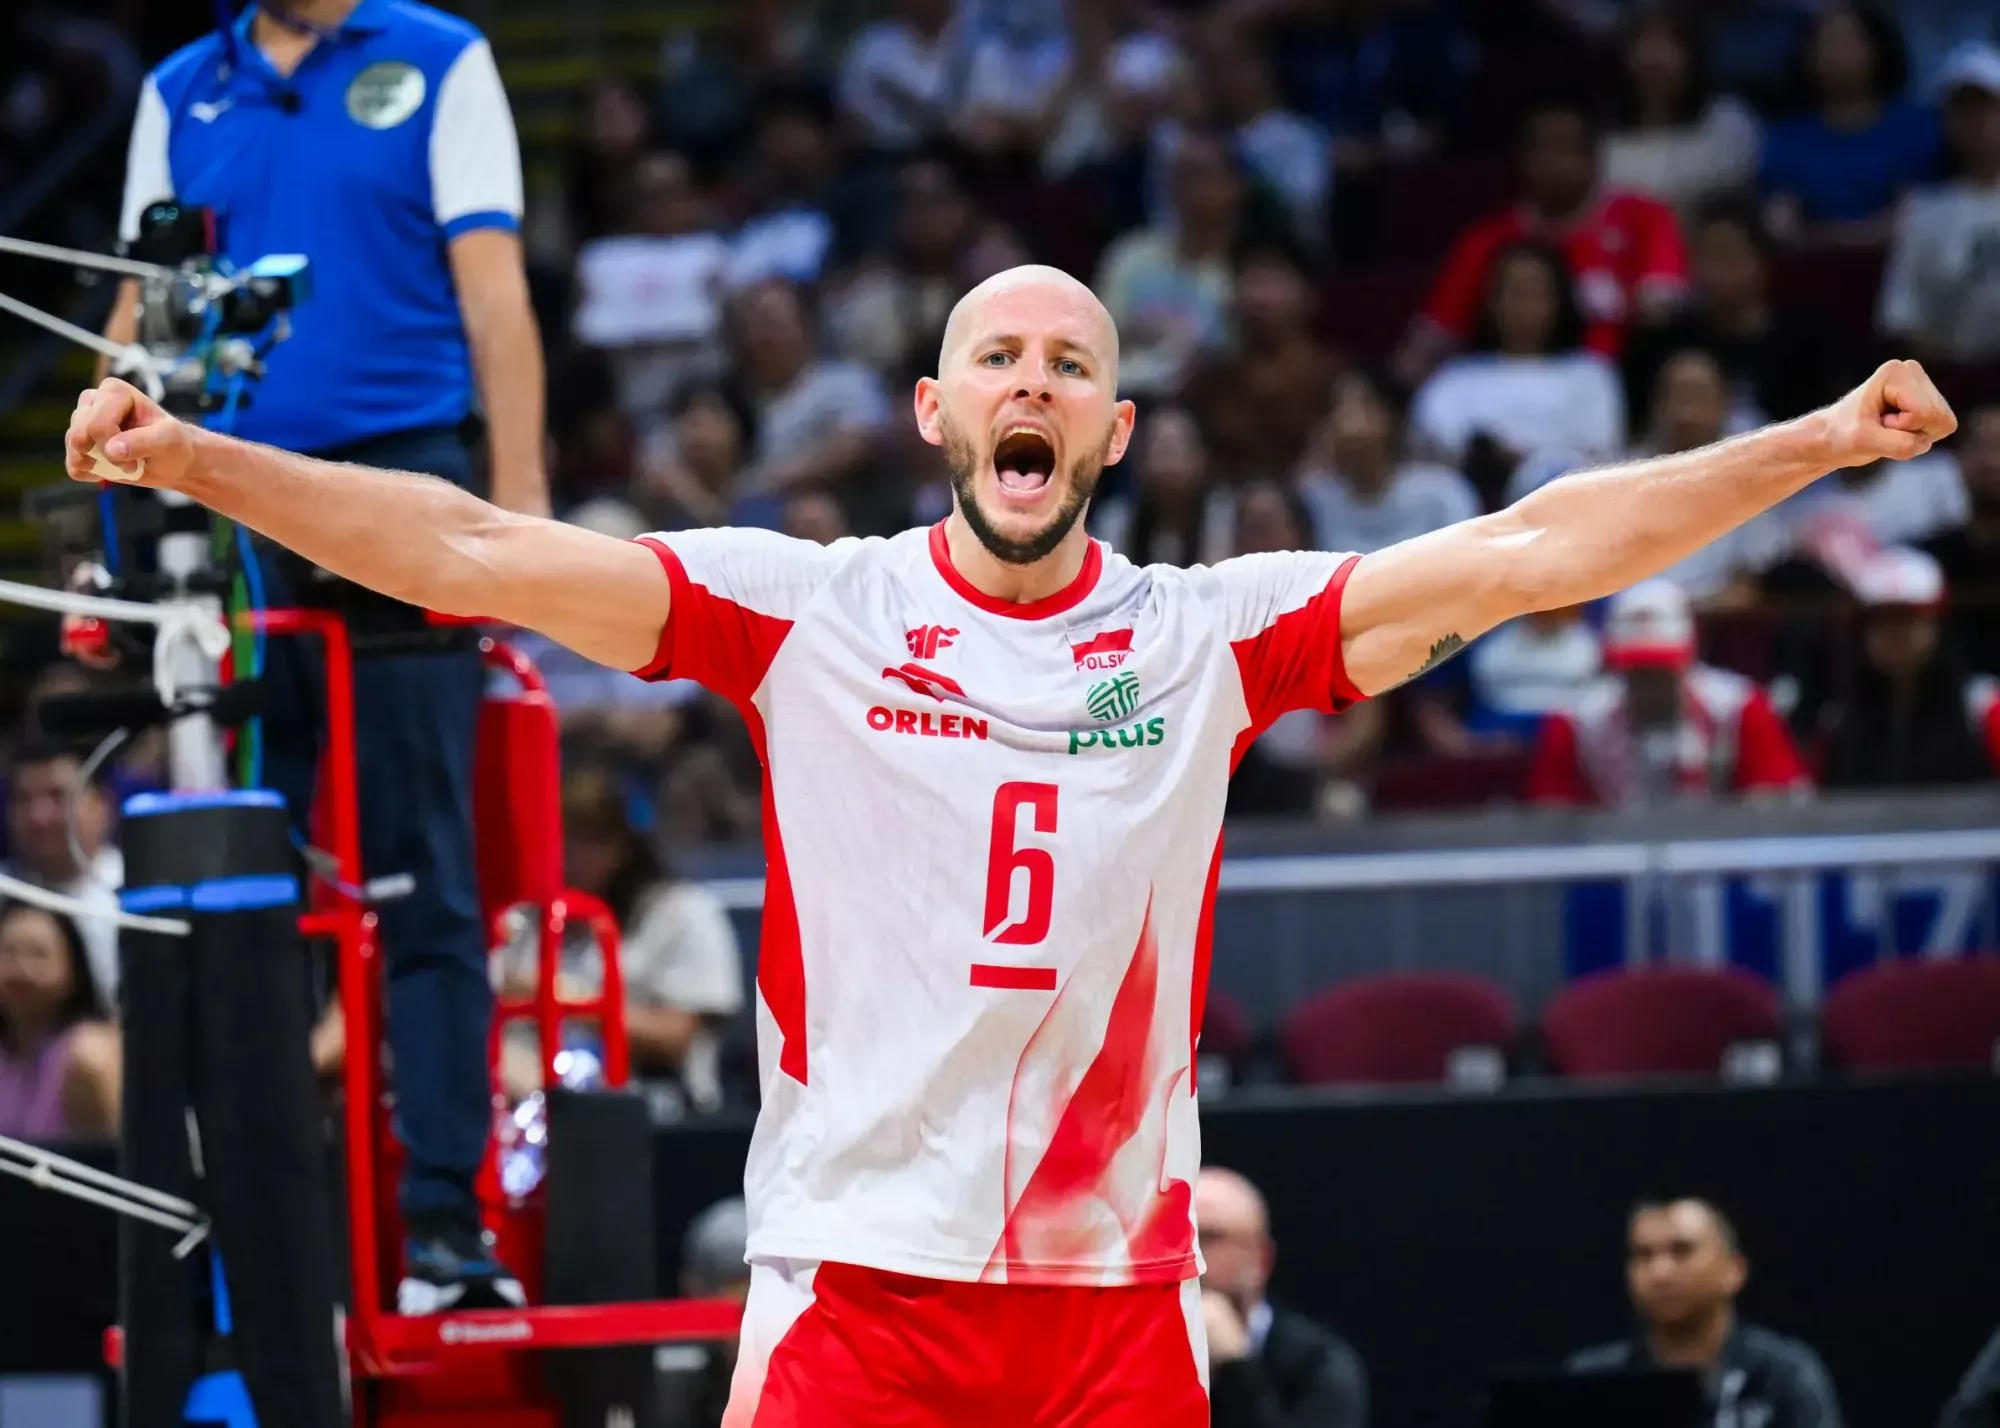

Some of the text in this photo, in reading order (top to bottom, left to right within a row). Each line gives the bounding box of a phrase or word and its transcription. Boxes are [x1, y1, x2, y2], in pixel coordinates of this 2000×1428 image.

[866, 706, 988, 740] ORLEN
[1068, 717, 1165, 755] plus
[982, 781, 1058, 945] 6
